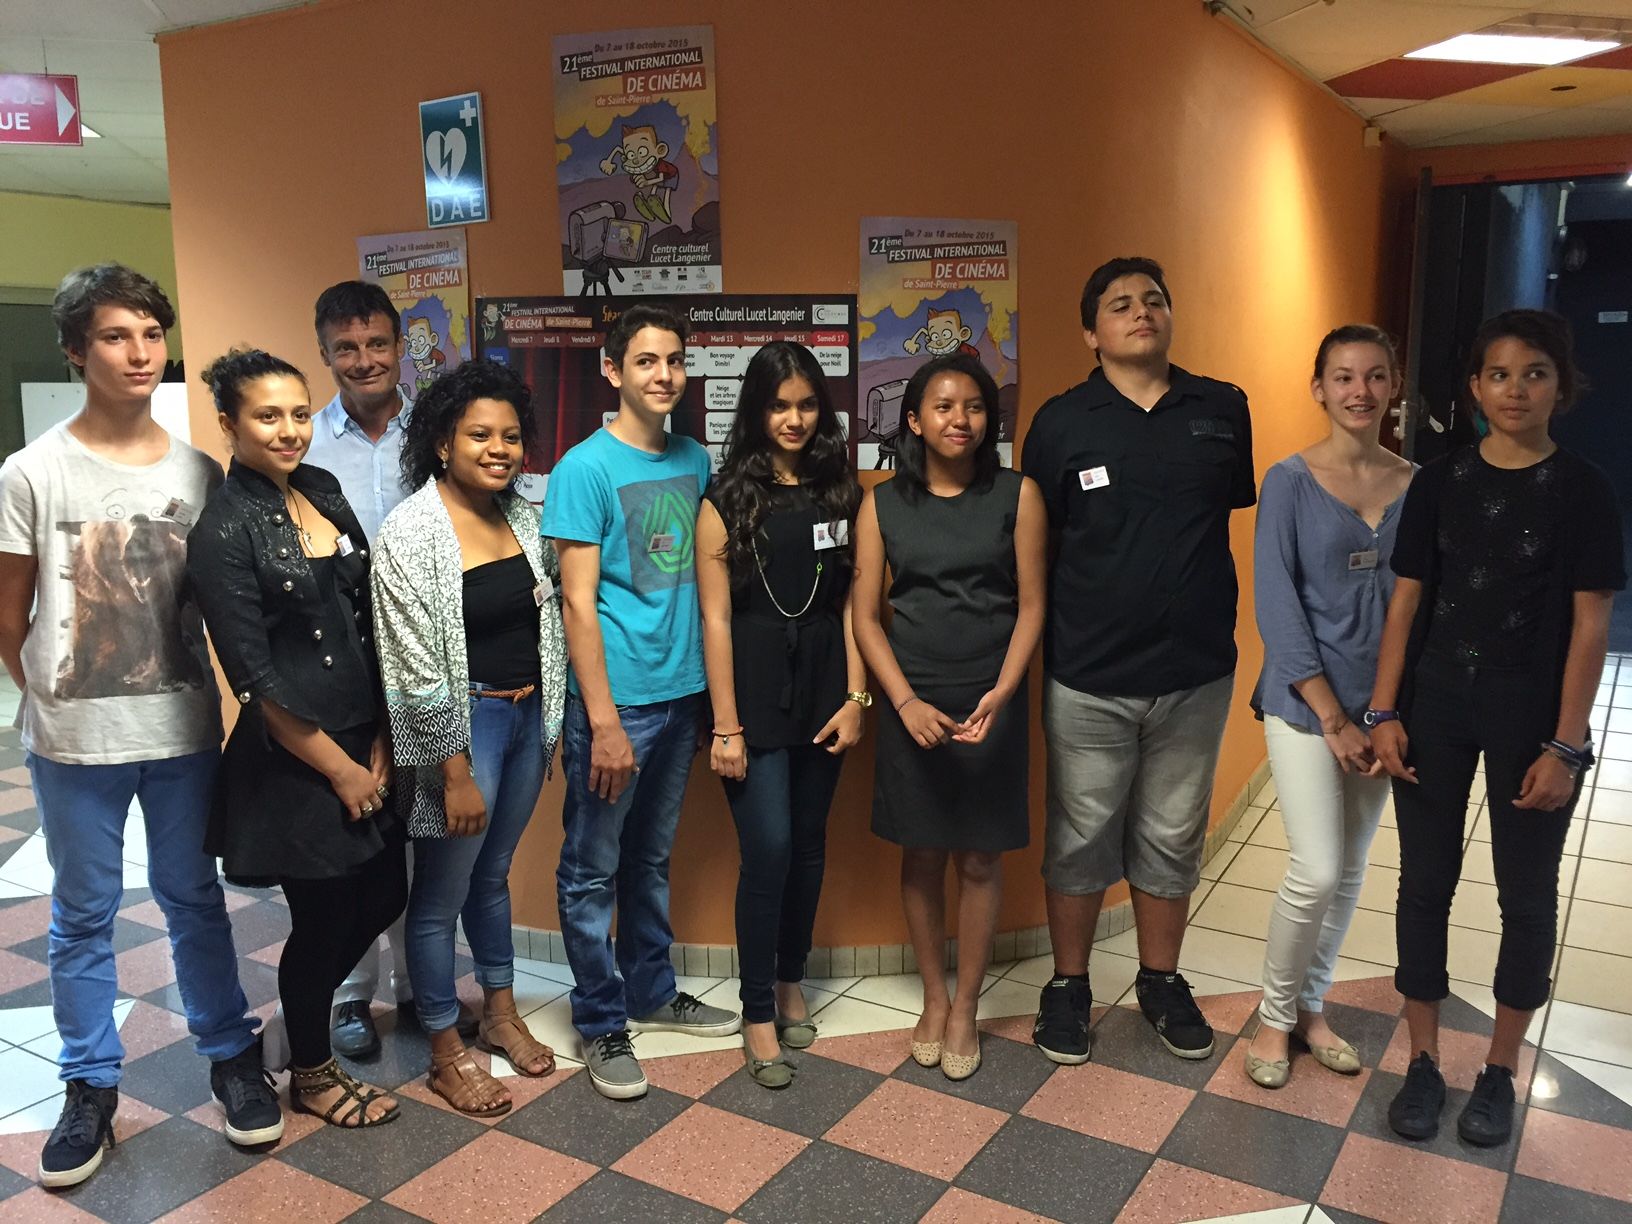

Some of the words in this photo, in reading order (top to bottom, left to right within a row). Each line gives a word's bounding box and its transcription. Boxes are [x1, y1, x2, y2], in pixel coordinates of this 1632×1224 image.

[625, 42, 635, 50] 18
[636, 39, 666, 50] octobre
[668, 38, 689, 48] 2015
[562, 53, 593, 73] 21ème
[580, 63, 623, 80] FESTIVAL
[624, 51, 701, 72] INTERNATIONAL
[626, 76, 646, 93] DE
[648, 70, 703, 91] CINÉMA
[596, 97, 606, 106] de
[607, 94, 652, 105] Saint-Pierre
[430, 191, 482, 222] DAE
[904, 229, 915, 238] Du
[916, 229, 922, 238] 7
[935, 229, 945, 238] 18
[946, 230, 974, 239] octobre
[975, 231, 995, 240] 2015
[652, 244, 677, 254] Centre
[678, 243, 709, 253] culturel
[870, 237, 902, 254] 21ème
[888, 248, 932, 262] FESTIVAL
[933, 243, 1006, 258] INTERNATIONAL
[378, 263, 407, 277] FESTIVAL
[407, 251, 459, 270] INTERNATIONAL
[650, 253, 671, 263] Lucet
[672, 253, 712, 265] Langenier
[934, 263, 952, 279] DE
[955, 260, 1006, 278] CINÉMA
[409, 274, 421, 289] DE
[423, 269, 460, 287] CINÉMA
[904, 280, 914, 288] de
[915, 278, 958, 289] Saint-Pierre
[511, 308, 533, 317] FESTIVAL
[533, 306, 575, 316] INTERNATIONAL
[689, 306, 713, 322] Centre
[715, 306, 744, 322] Culturel
[746, 306, 766, 322] Lucet
[767, 306, 805, 325] Langenier
[504, 320, 514, 329] DE
[515, 318, 543, 329] CINÉMA
[710, 335, 726, 343] Mardi
[726, 335, 734, 343] 13
[743, 335, 765, 343] Mercredi
[765, 335, 773, 343] 14
[817, 335, 837, 343] Samedi
[837, 335, 845, 343] 17
